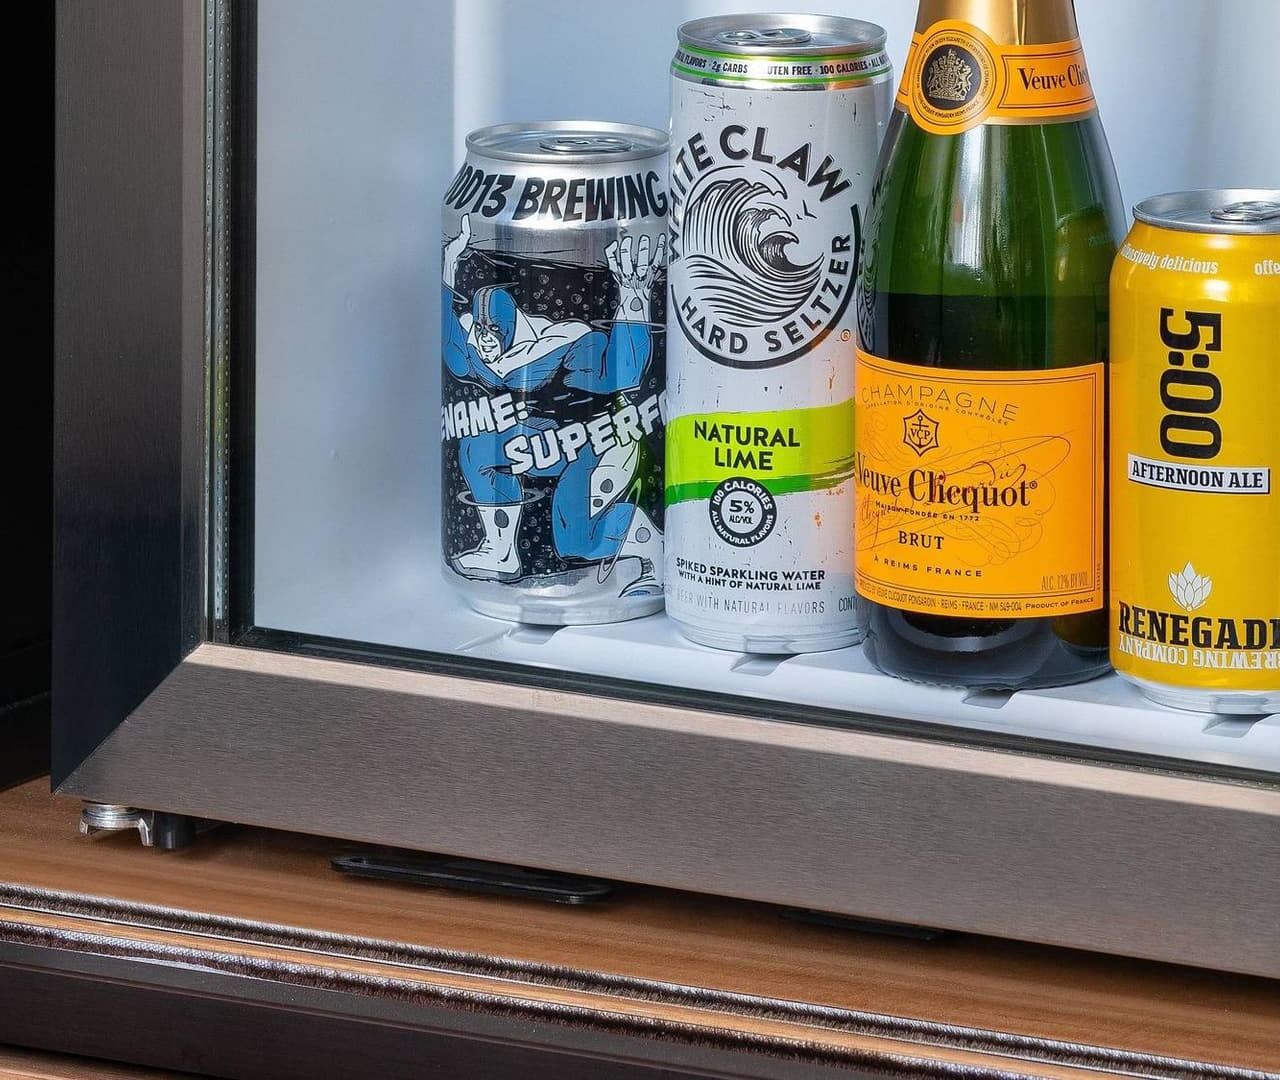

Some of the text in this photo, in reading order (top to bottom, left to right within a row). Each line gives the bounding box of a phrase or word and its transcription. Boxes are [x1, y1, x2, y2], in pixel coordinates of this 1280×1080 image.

[711, 61, 721, 73] 2g
[722, 63, 748, 74] CARBS
[792, 66, 812, 75] FREE
[820, 65, 835, 75] 100
[836, 61, 869, 73] CALORIES
[1016, 67, 1066, 90] Veuve
[720, 124, 852, 202] CLAW
[512, 171, 669, 222] BREWING
[1160, 253, 1219, 274] delicious
[681, 234, 851, 354] HARD SELTZER
[1160, 307, 1222, 460] 5:00
[862, 384, 1019, 421] CHAMPAGNE
[441, 392, 528, 440] NAME:
[694, 420, 800, 448] NATURAL
[910, 428, 931, 439] VCP
[714, 447, 773, 471] LIME
[855, 451, 901, 497] Veuve
[1132, 460, 1263, 489] AFTERNOON ALE
[713, 480, 773, 510] 100 CALORIES
[729, 500, 755, 514] 5%
[712, 510, 720, 525] ALL
[717, 525, 751, 545] NATURAL
[898, 531, 944, 549] BRUT
[676, 557, 825, 581] SPIKED SPARKLING WATER
[884, 558, 918, 571] REIMS
[926, 567, 982, 577] FRANCE
[679, 570, 821, 592] WITH A HINT OF NATURAL LIME
[697, 593, 719, 610] WITH
[778, 601, 825, 615] FLAVORS
[1071, 597, 1094, 605] FRANCE
[1119, 631, 1188, 666] COMPANY
